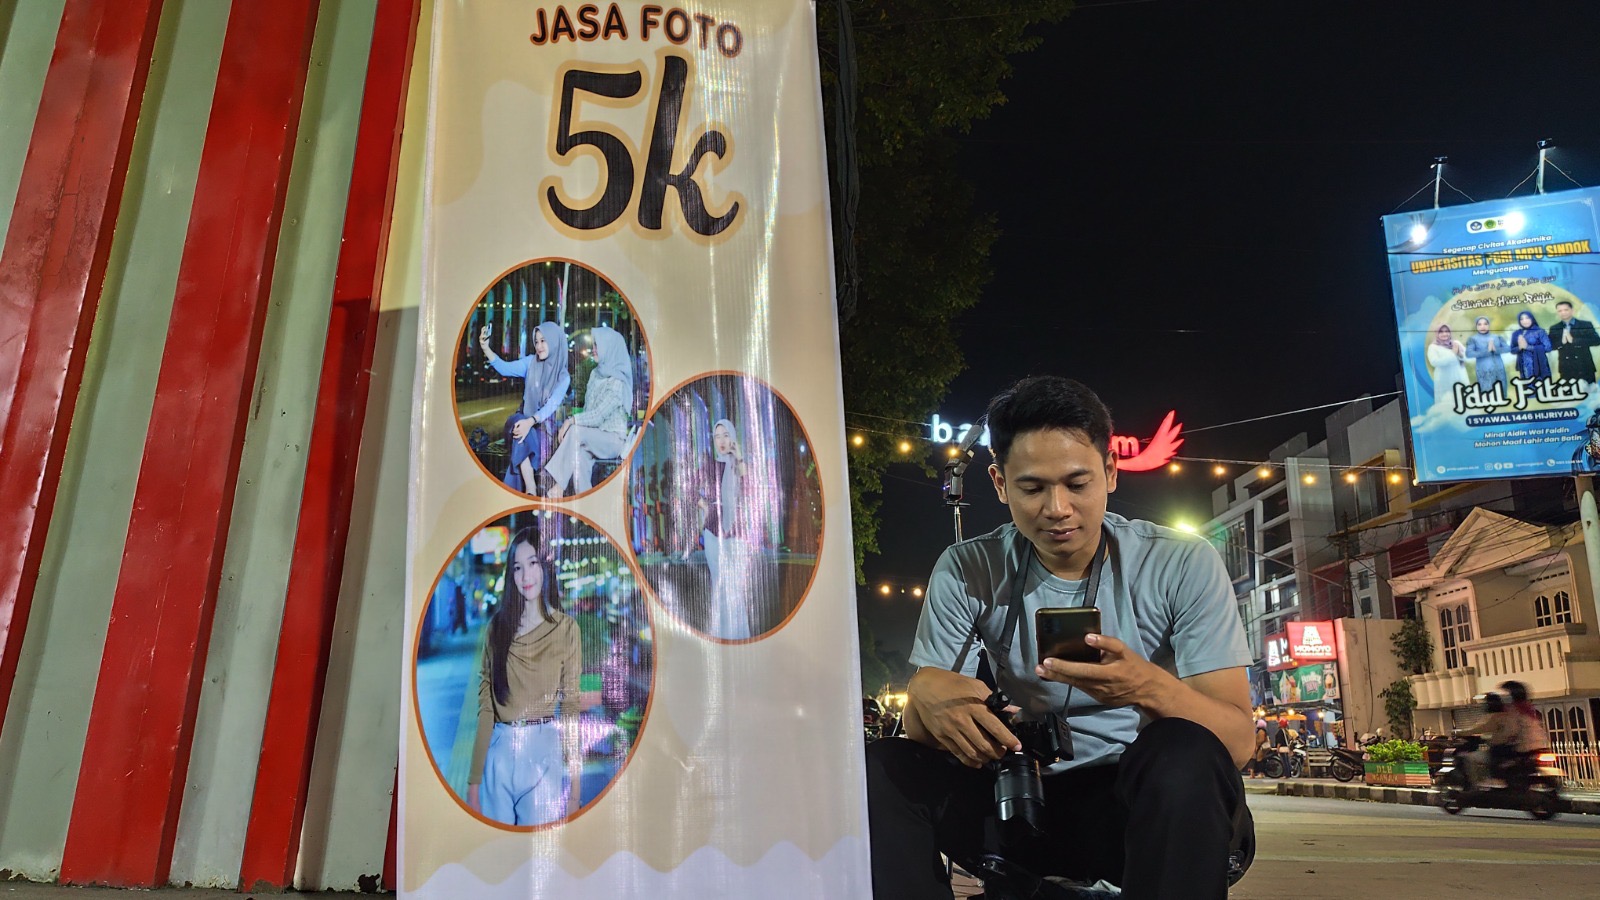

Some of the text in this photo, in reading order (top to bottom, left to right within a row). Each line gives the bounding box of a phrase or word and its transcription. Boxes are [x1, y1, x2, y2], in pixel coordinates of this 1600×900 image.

[530, 3, 743, 58] JASA FOTO
[543, 52, 743, 239] 5k
[1442, 235, 1552, 254] Segenap Civitas Akademika
[1410, 254, 1484, 275] UNIVERSITAS
[1514, 245, 1544, 261] MPU
[1545, 239, 1592, 258] SINDOK
[1472, 264, 1529, 276] Mengucapkan
[1510, 376, 1589, 410] Fitri
[1473, 416, 1511, 424] SYAWAL
[1512, 413, 1533, 422] 1446
[1534, 410, 1577, 420] HIJRIYAH
[1474, 440, 1500, 448] Mohon
[1502, 438, 1523, 446] Maaf
[1523, 437, 1543, 445] Lahir
[1561, 434, 1583, 442] Batin
[1484, 431, 1505, 439] Minal
[1528, 428, 1544, 436] Wal
